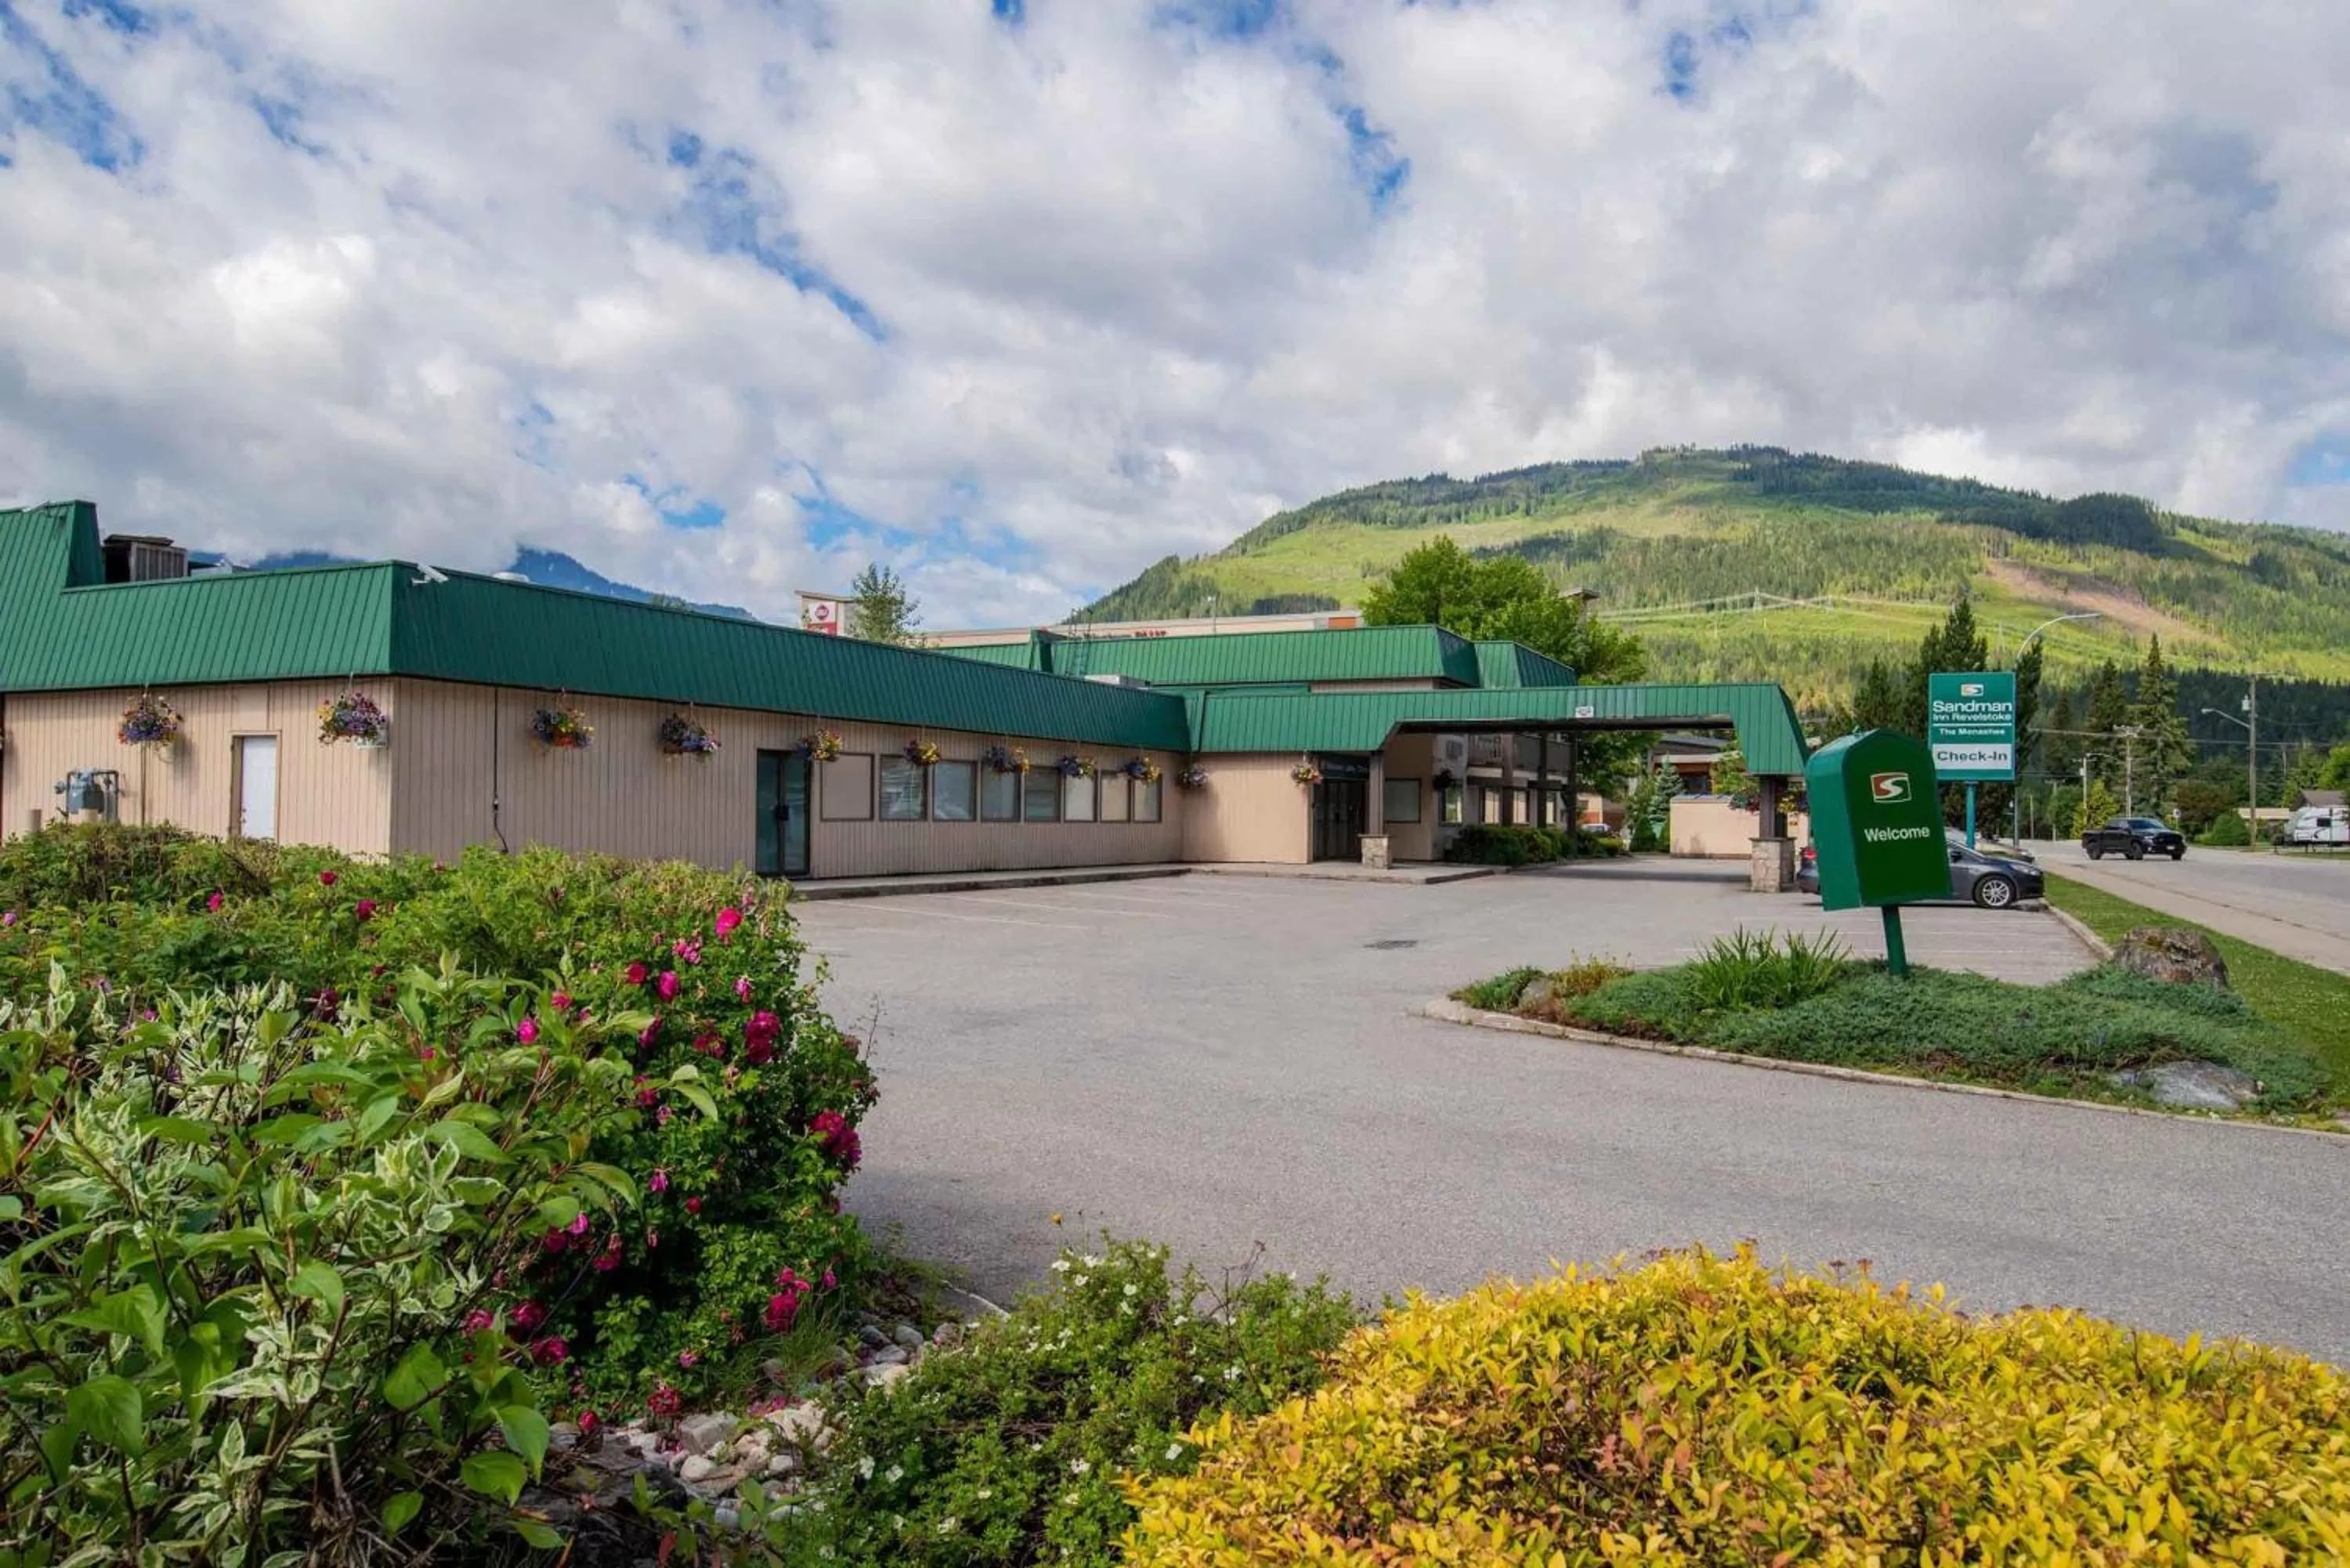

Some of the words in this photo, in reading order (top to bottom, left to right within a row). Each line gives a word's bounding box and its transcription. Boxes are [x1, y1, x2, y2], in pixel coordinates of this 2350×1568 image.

[1932, 700, 2012, 713] Sandman
[1932, 713, 1950, 721] Inn
[1952, 713, 2012, 721] Revelstoke
[1937, 751, 2008, 762] Check-In
[1864, 826, 1931, 842] Welcome
